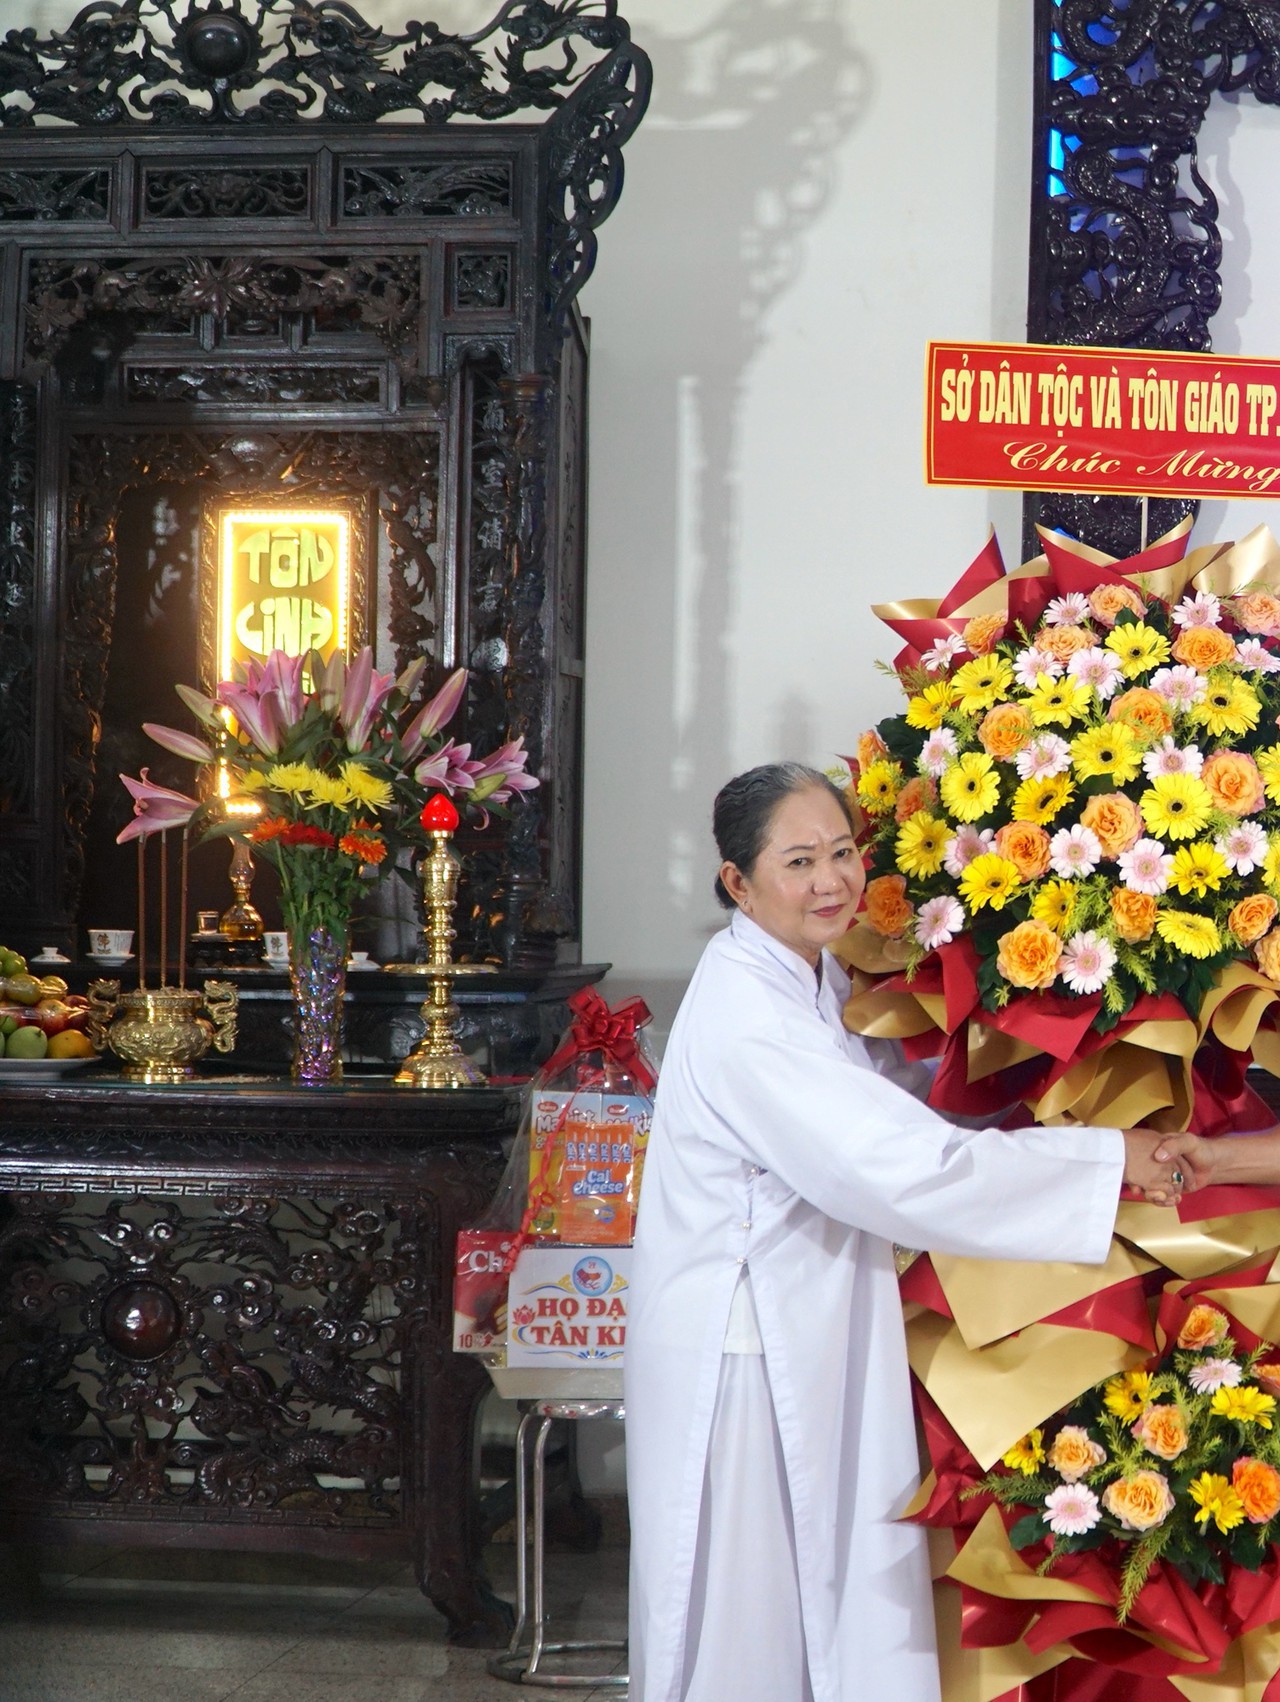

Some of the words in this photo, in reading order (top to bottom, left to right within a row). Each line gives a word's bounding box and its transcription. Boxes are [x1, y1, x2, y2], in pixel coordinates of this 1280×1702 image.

[941, 354, 976, 422] SỞ
[979, 360, 1031, 425] DÂN
[1038, 363, 1083, 438] TỘC
[1090, 366, 1122, 430] VÀ
[1128, 368, 1180, 433] TÔN
[1184, 372, 1239, 435] GIÁO
[1003, 442, 1121, 475] Chúc
[238, 526, 335, 588] TÔN
[536, 1298, 580, 1323] HỌ
[459, 1334, 472, 1348] 10
[530, 1320, 590, 1346] TÂN
